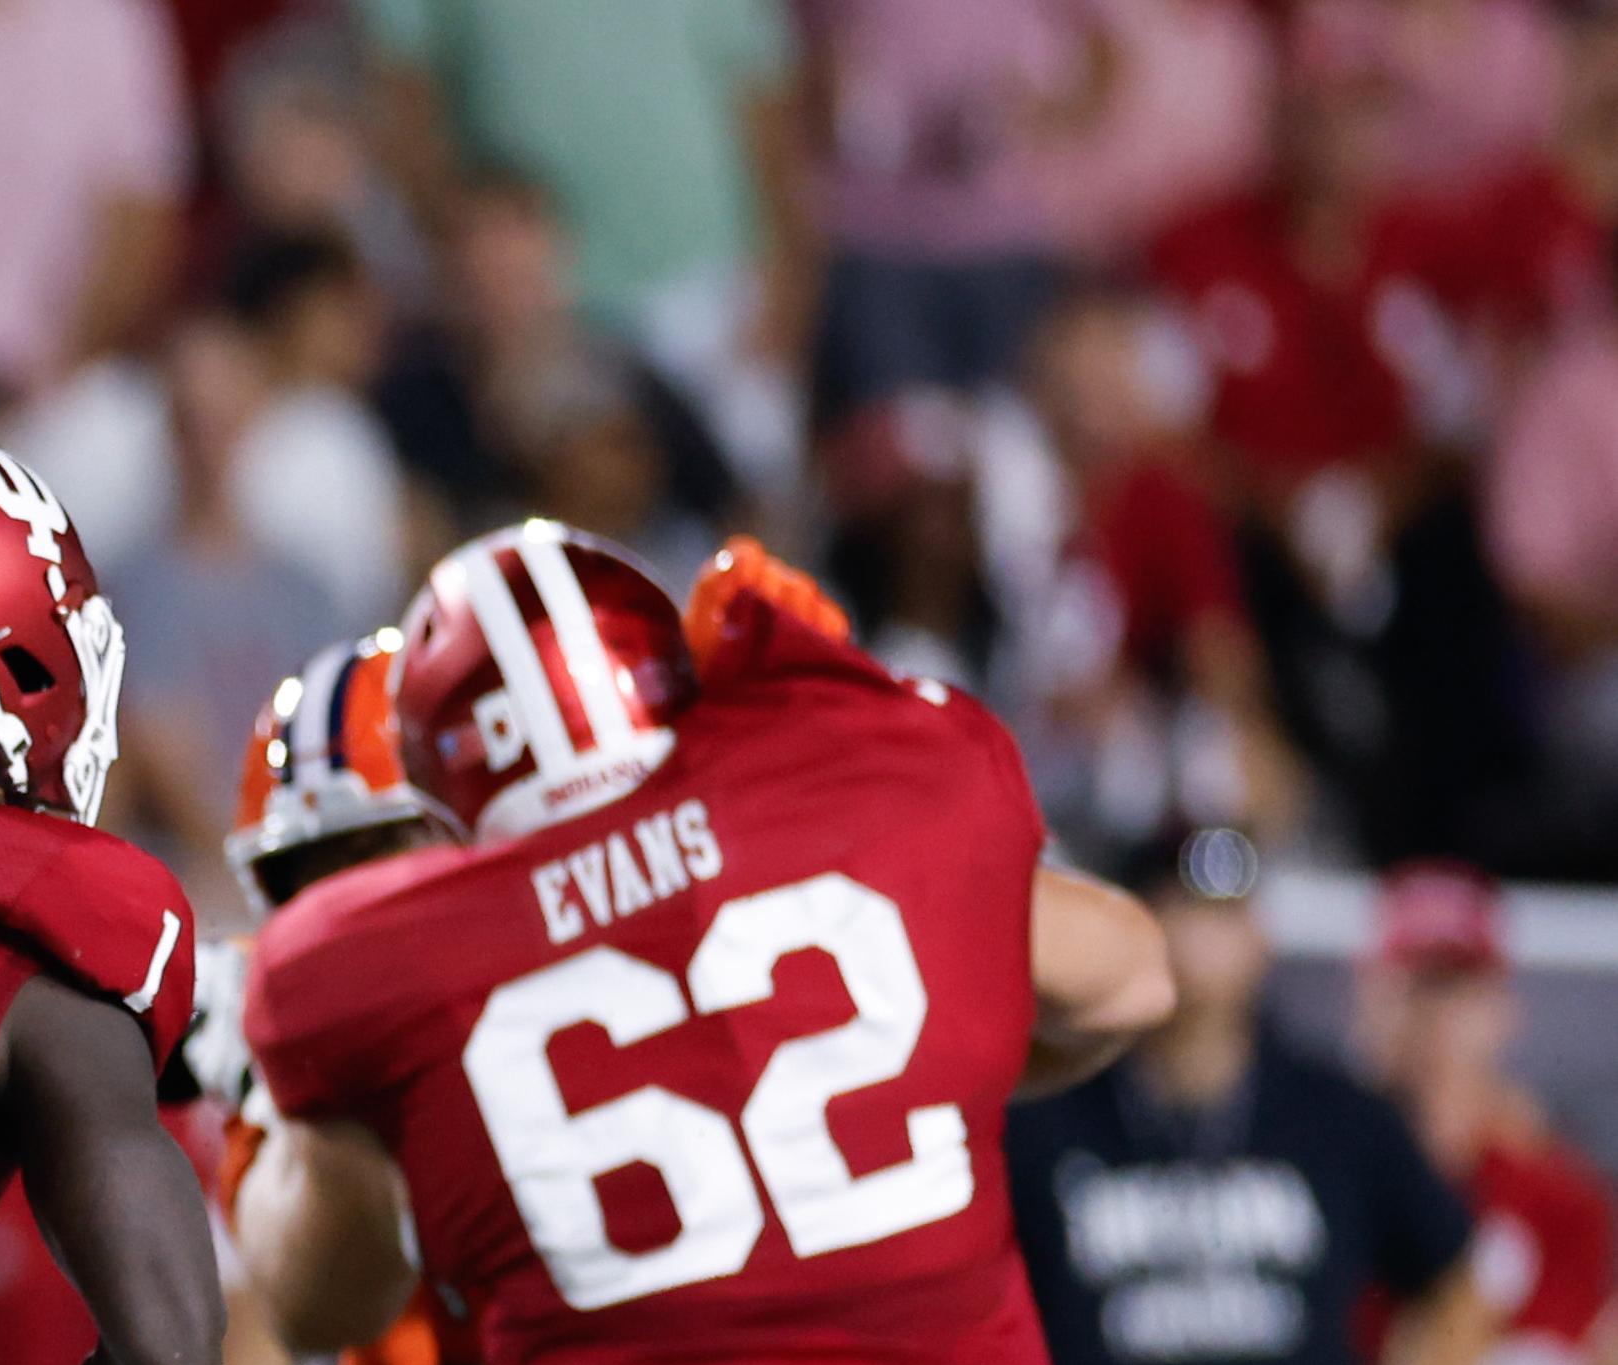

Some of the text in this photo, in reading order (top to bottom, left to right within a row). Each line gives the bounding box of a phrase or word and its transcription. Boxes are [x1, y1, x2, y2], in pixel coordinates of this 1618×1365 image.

[531, 797, 724, 946] EVANS
[122, 907, 182, 1014] 1
[461, 871, 974, 1313] 62
